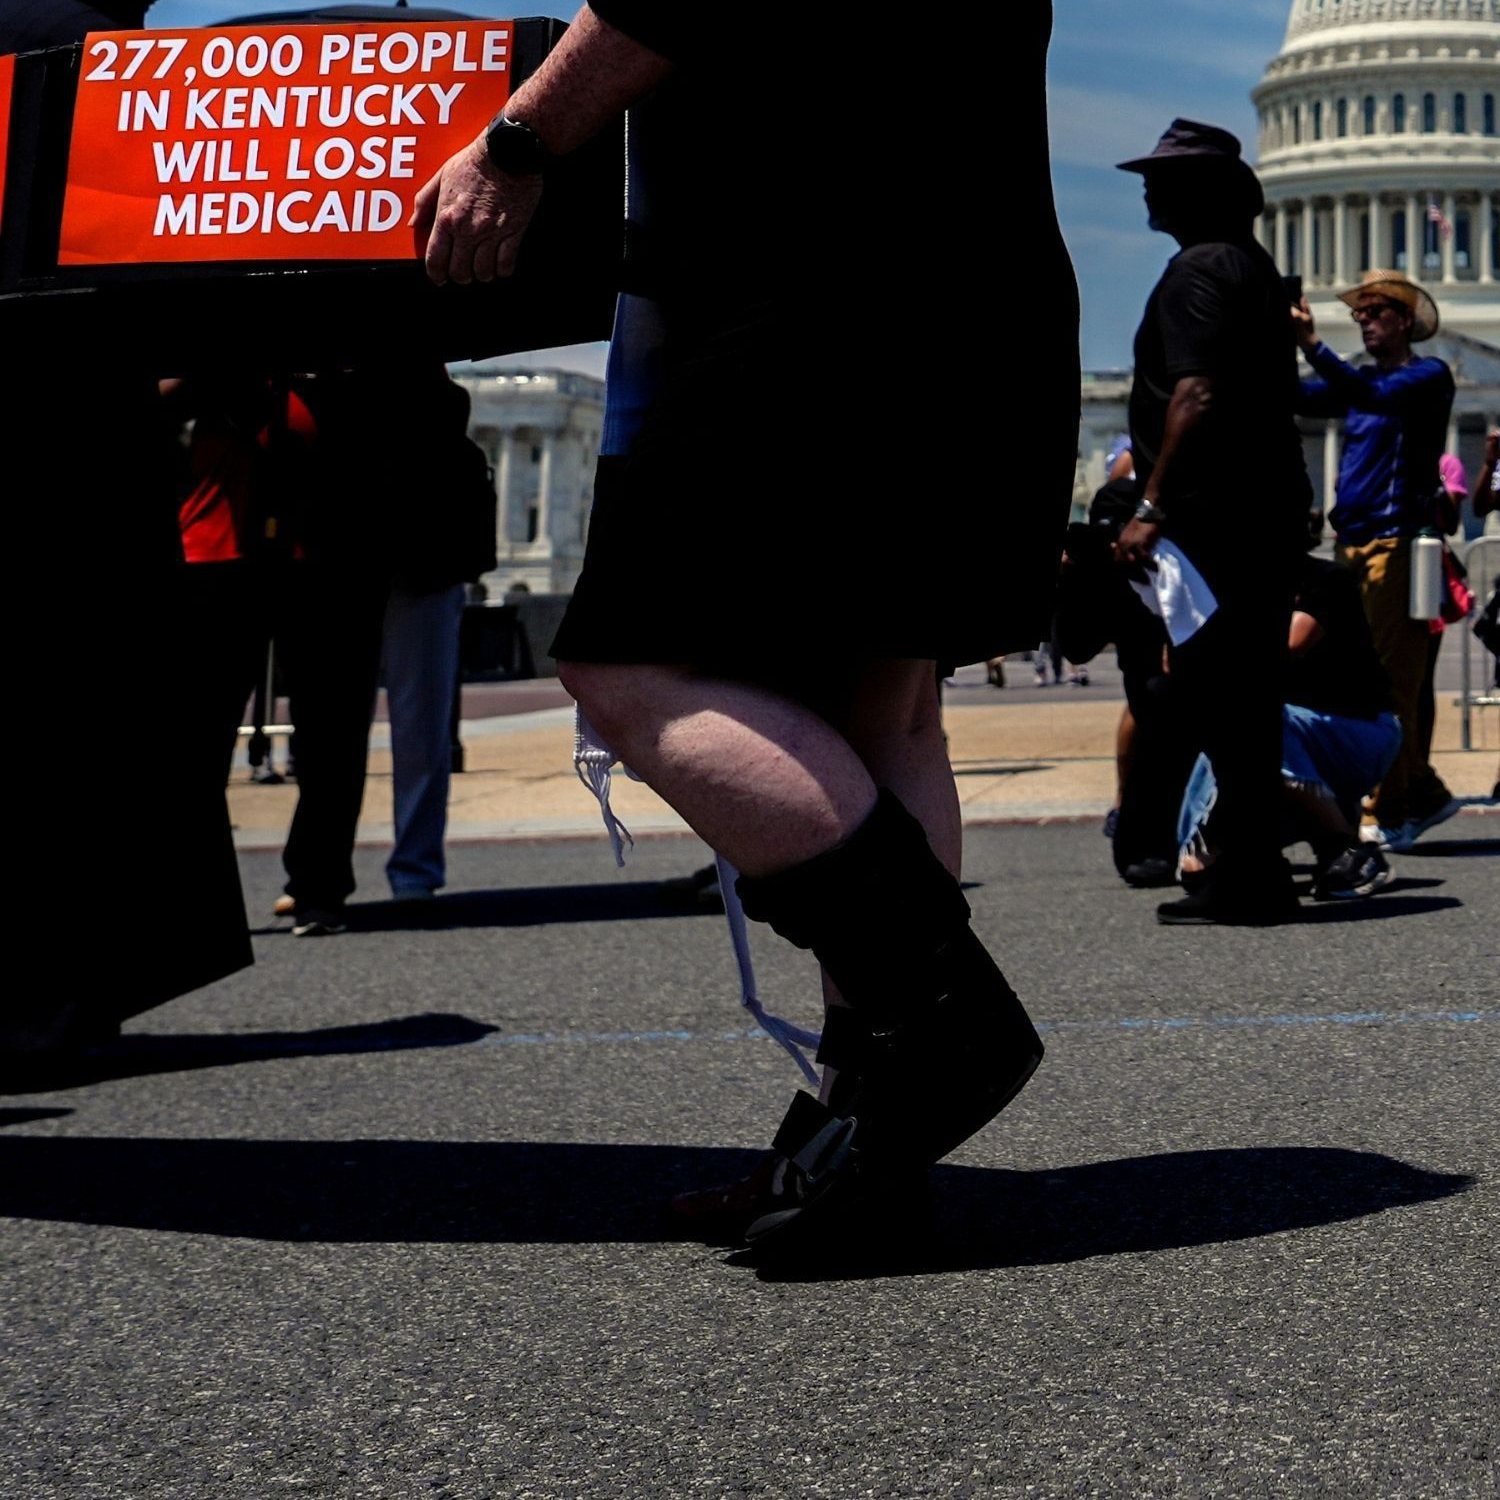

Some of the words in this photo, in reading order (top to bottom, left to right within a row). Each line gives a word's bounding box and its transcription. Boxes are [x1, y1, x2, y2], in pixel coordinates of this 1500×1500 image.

[85, 34, 303, 87] 277,000
[318, 30, 509, 75] PEOPLE
[117, 89, 171, 132] IN
[184, 83, 466, 130] KENTUCKY
[152, 139, 269, 183] WILL
[286, 136, 417, 180] LOSE
[153, 189, 403, 236] MEDICAID
